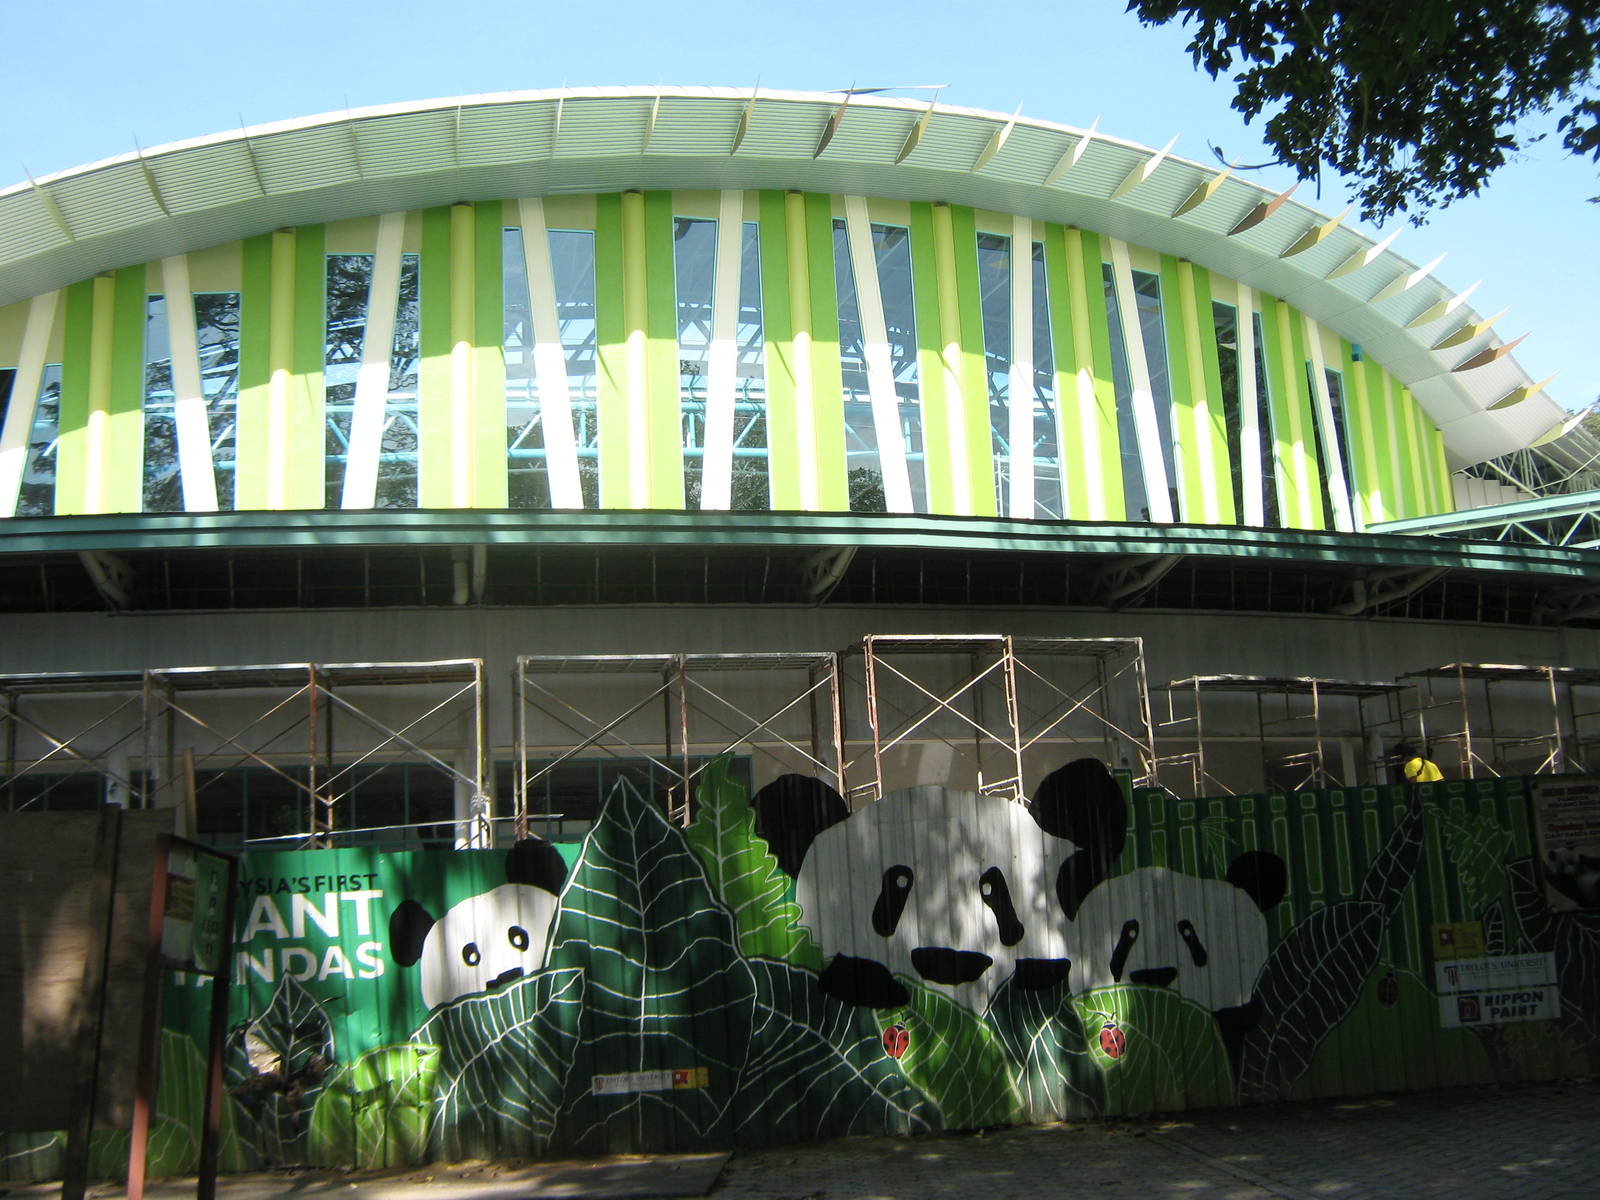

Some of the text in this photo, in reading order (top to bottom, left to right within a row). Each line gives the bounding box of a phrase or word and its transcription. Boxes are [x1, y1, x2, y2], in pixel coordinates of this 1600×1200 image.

[314, 873, 378, 892] FIRST
[232, 889, 385, 944] ANT
[174, 941, 386, 987] NDAS
[1484, 991, 1544, 1007] NIPPON
[1490, 1004, 1539, 1019] PAINT
